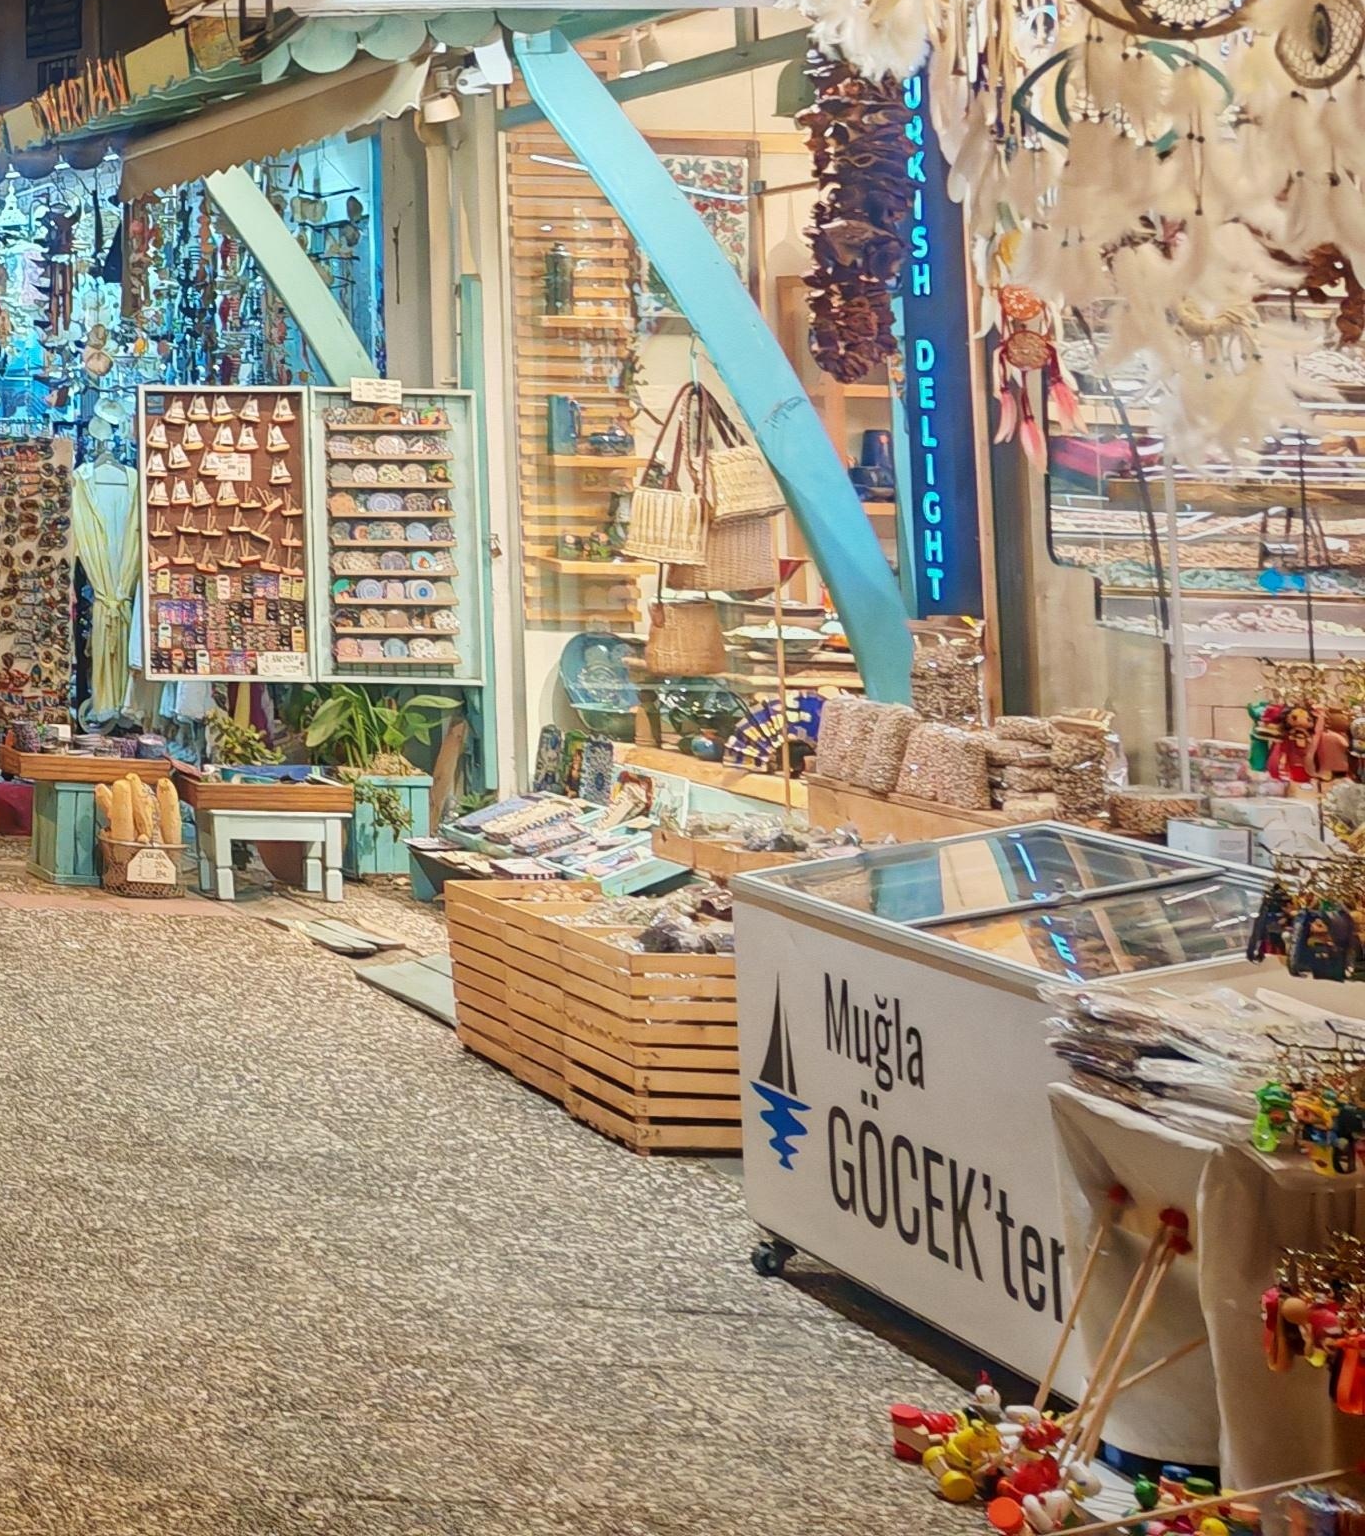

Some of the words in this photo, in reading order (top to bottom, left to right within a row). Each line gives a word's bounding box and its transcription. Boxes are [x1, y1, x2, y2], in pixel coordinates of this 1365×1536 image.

[902, 75, 932, 297] URKISH
[915, 338, 945, 601] DELIGHT
[824, 971, 925, 1092] Muğla
